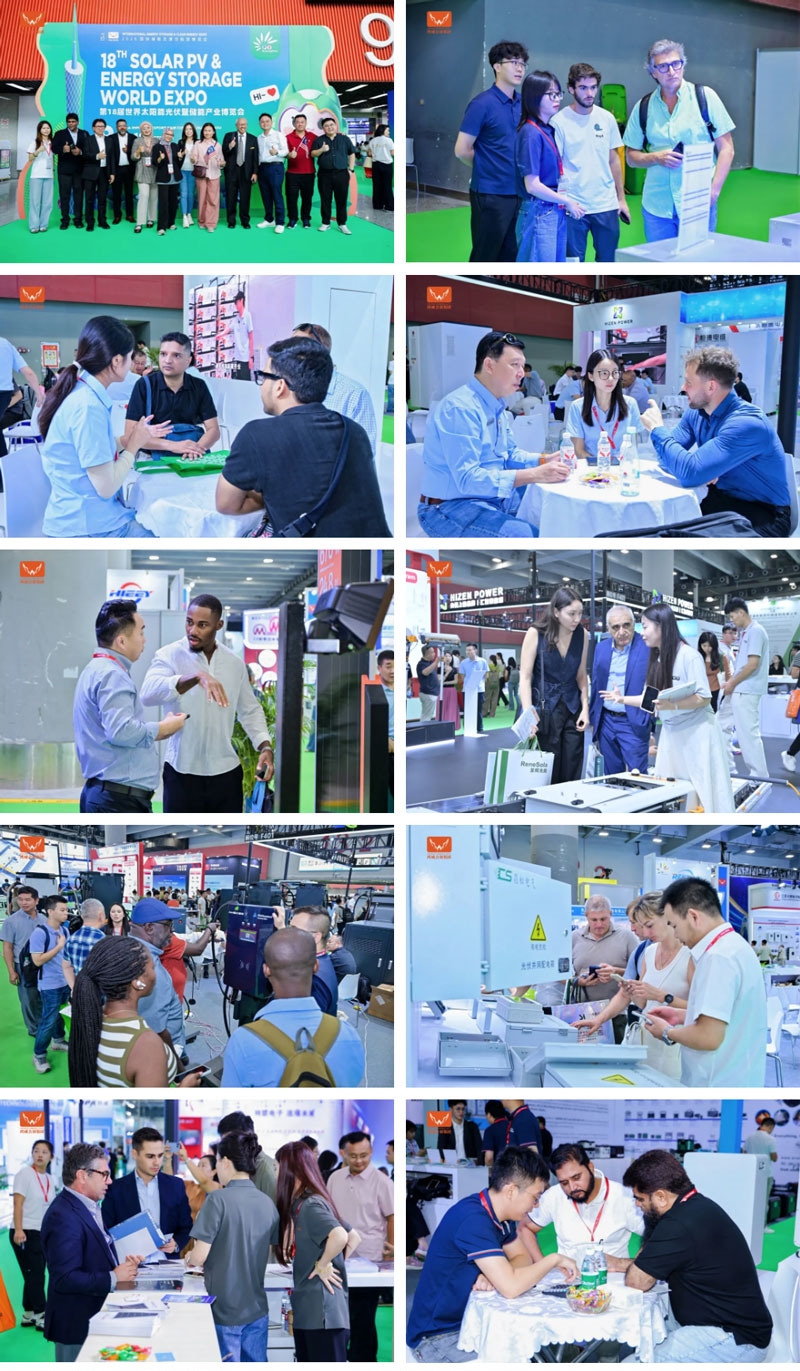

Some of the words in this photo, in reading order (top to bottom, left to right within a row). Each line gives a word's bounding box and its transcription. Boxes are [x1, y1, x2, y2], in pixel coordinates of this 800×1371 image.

[130, 53, 184, 69] SOLAR
[187, 53, 208, 69] PV
[211, 53, 221, 69] &
[100, 72, 164, 87] ENERGY
[168, 72, 243, 88] STORAGE
[100, 90, 161, 105] WORLD
[164, 90, 208, 106] EXPO
[474, 587, 504, 600] POWER
